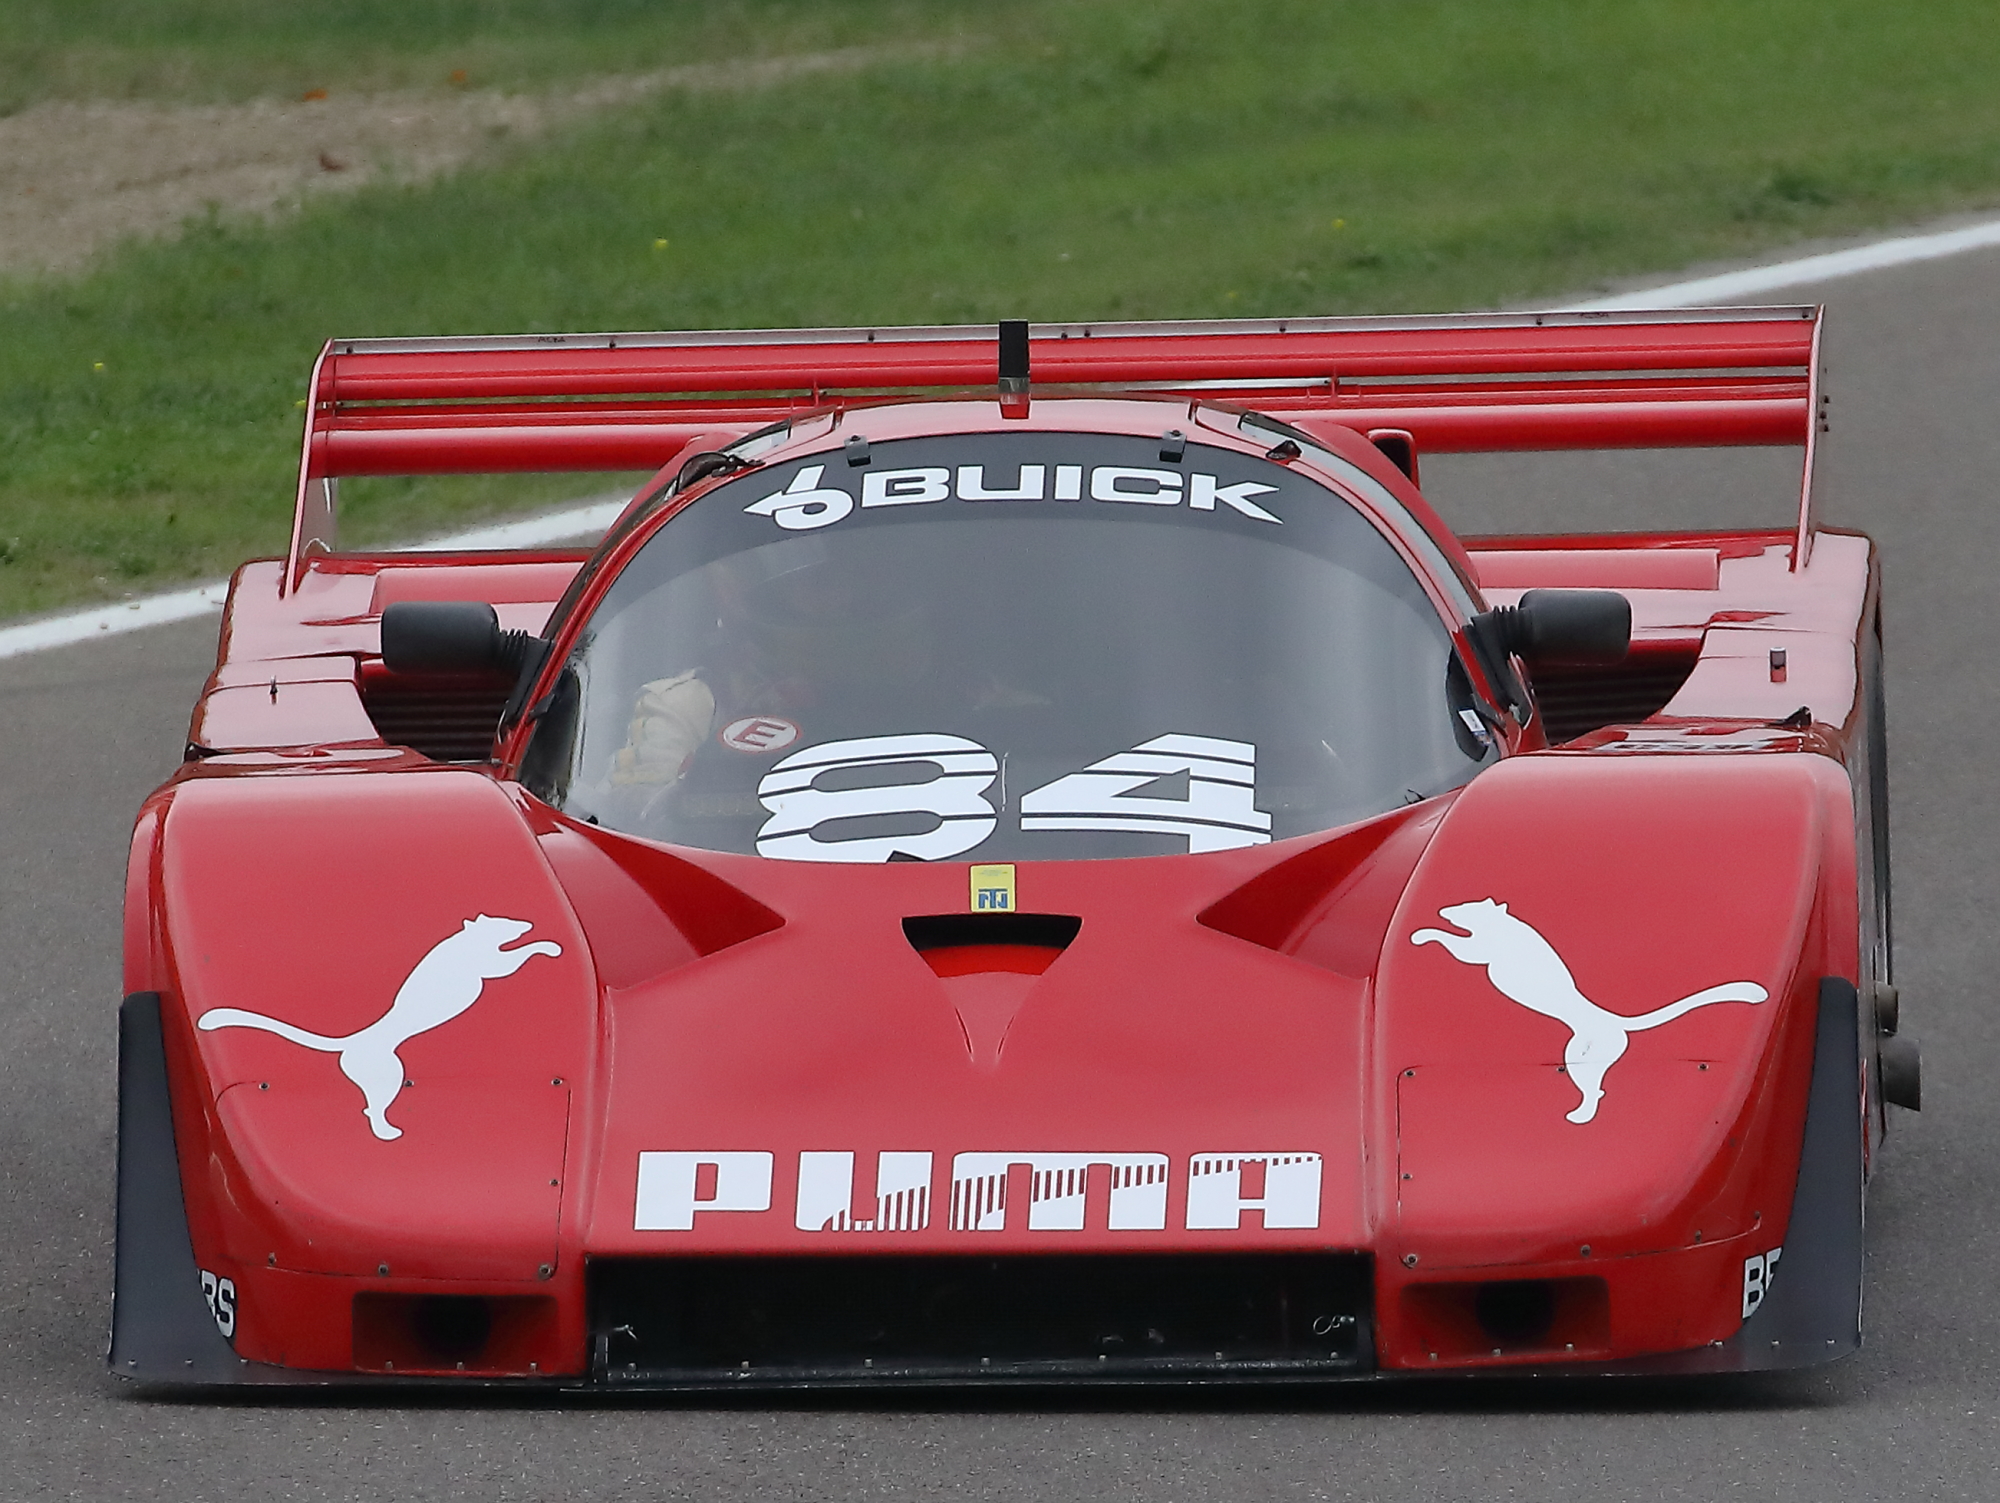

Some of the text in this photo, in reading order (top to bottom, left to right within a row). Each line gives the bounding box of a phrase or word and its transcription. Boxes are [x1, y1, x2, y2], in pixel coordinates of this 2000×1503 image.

[861, 463, 1285, 525] BUICK
[732, 719, 788, 748] E
[755, 732, 1273, 864] 84
[633, 1150, 1324, 1231] PUMA
